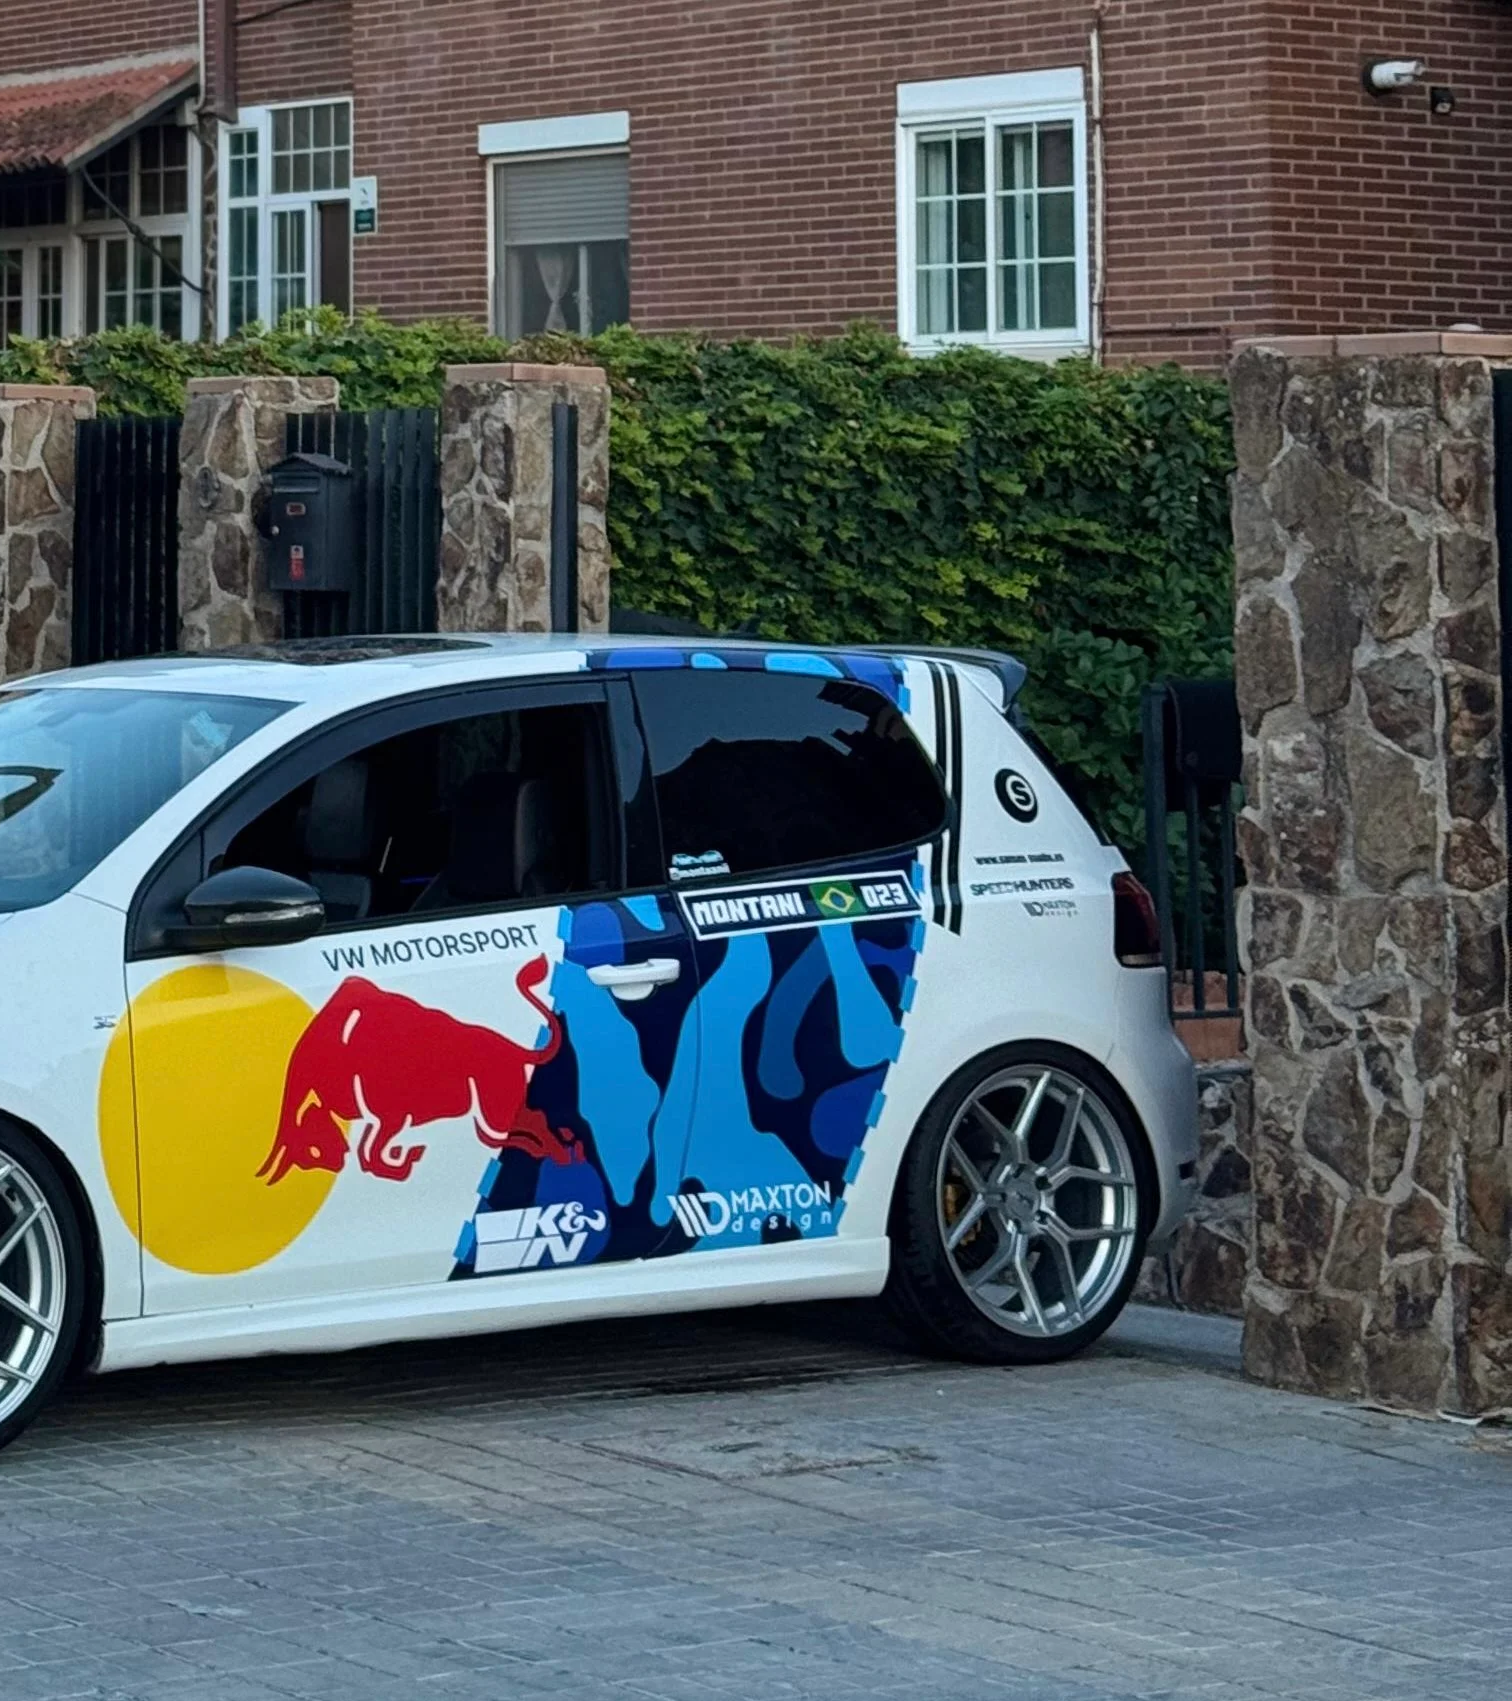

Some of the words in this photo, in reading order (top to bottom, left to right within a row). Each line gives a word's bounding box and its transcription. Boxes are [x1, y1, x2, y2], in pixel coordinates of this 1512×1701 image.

[692, 892, 806, 926] MONTANI
[860, 882, 909, 908] 023
[970, 877, 1074, 896] SPEEDHUNTERS
[322, 945, 366, 972] VW
[370, 924, 540, 967] MOTORSPORT
[730, 1180, 831, 1213] MAXTON
[518, 1201, 607, 1268] K&N
[732, 1210, 832, 1233] design
